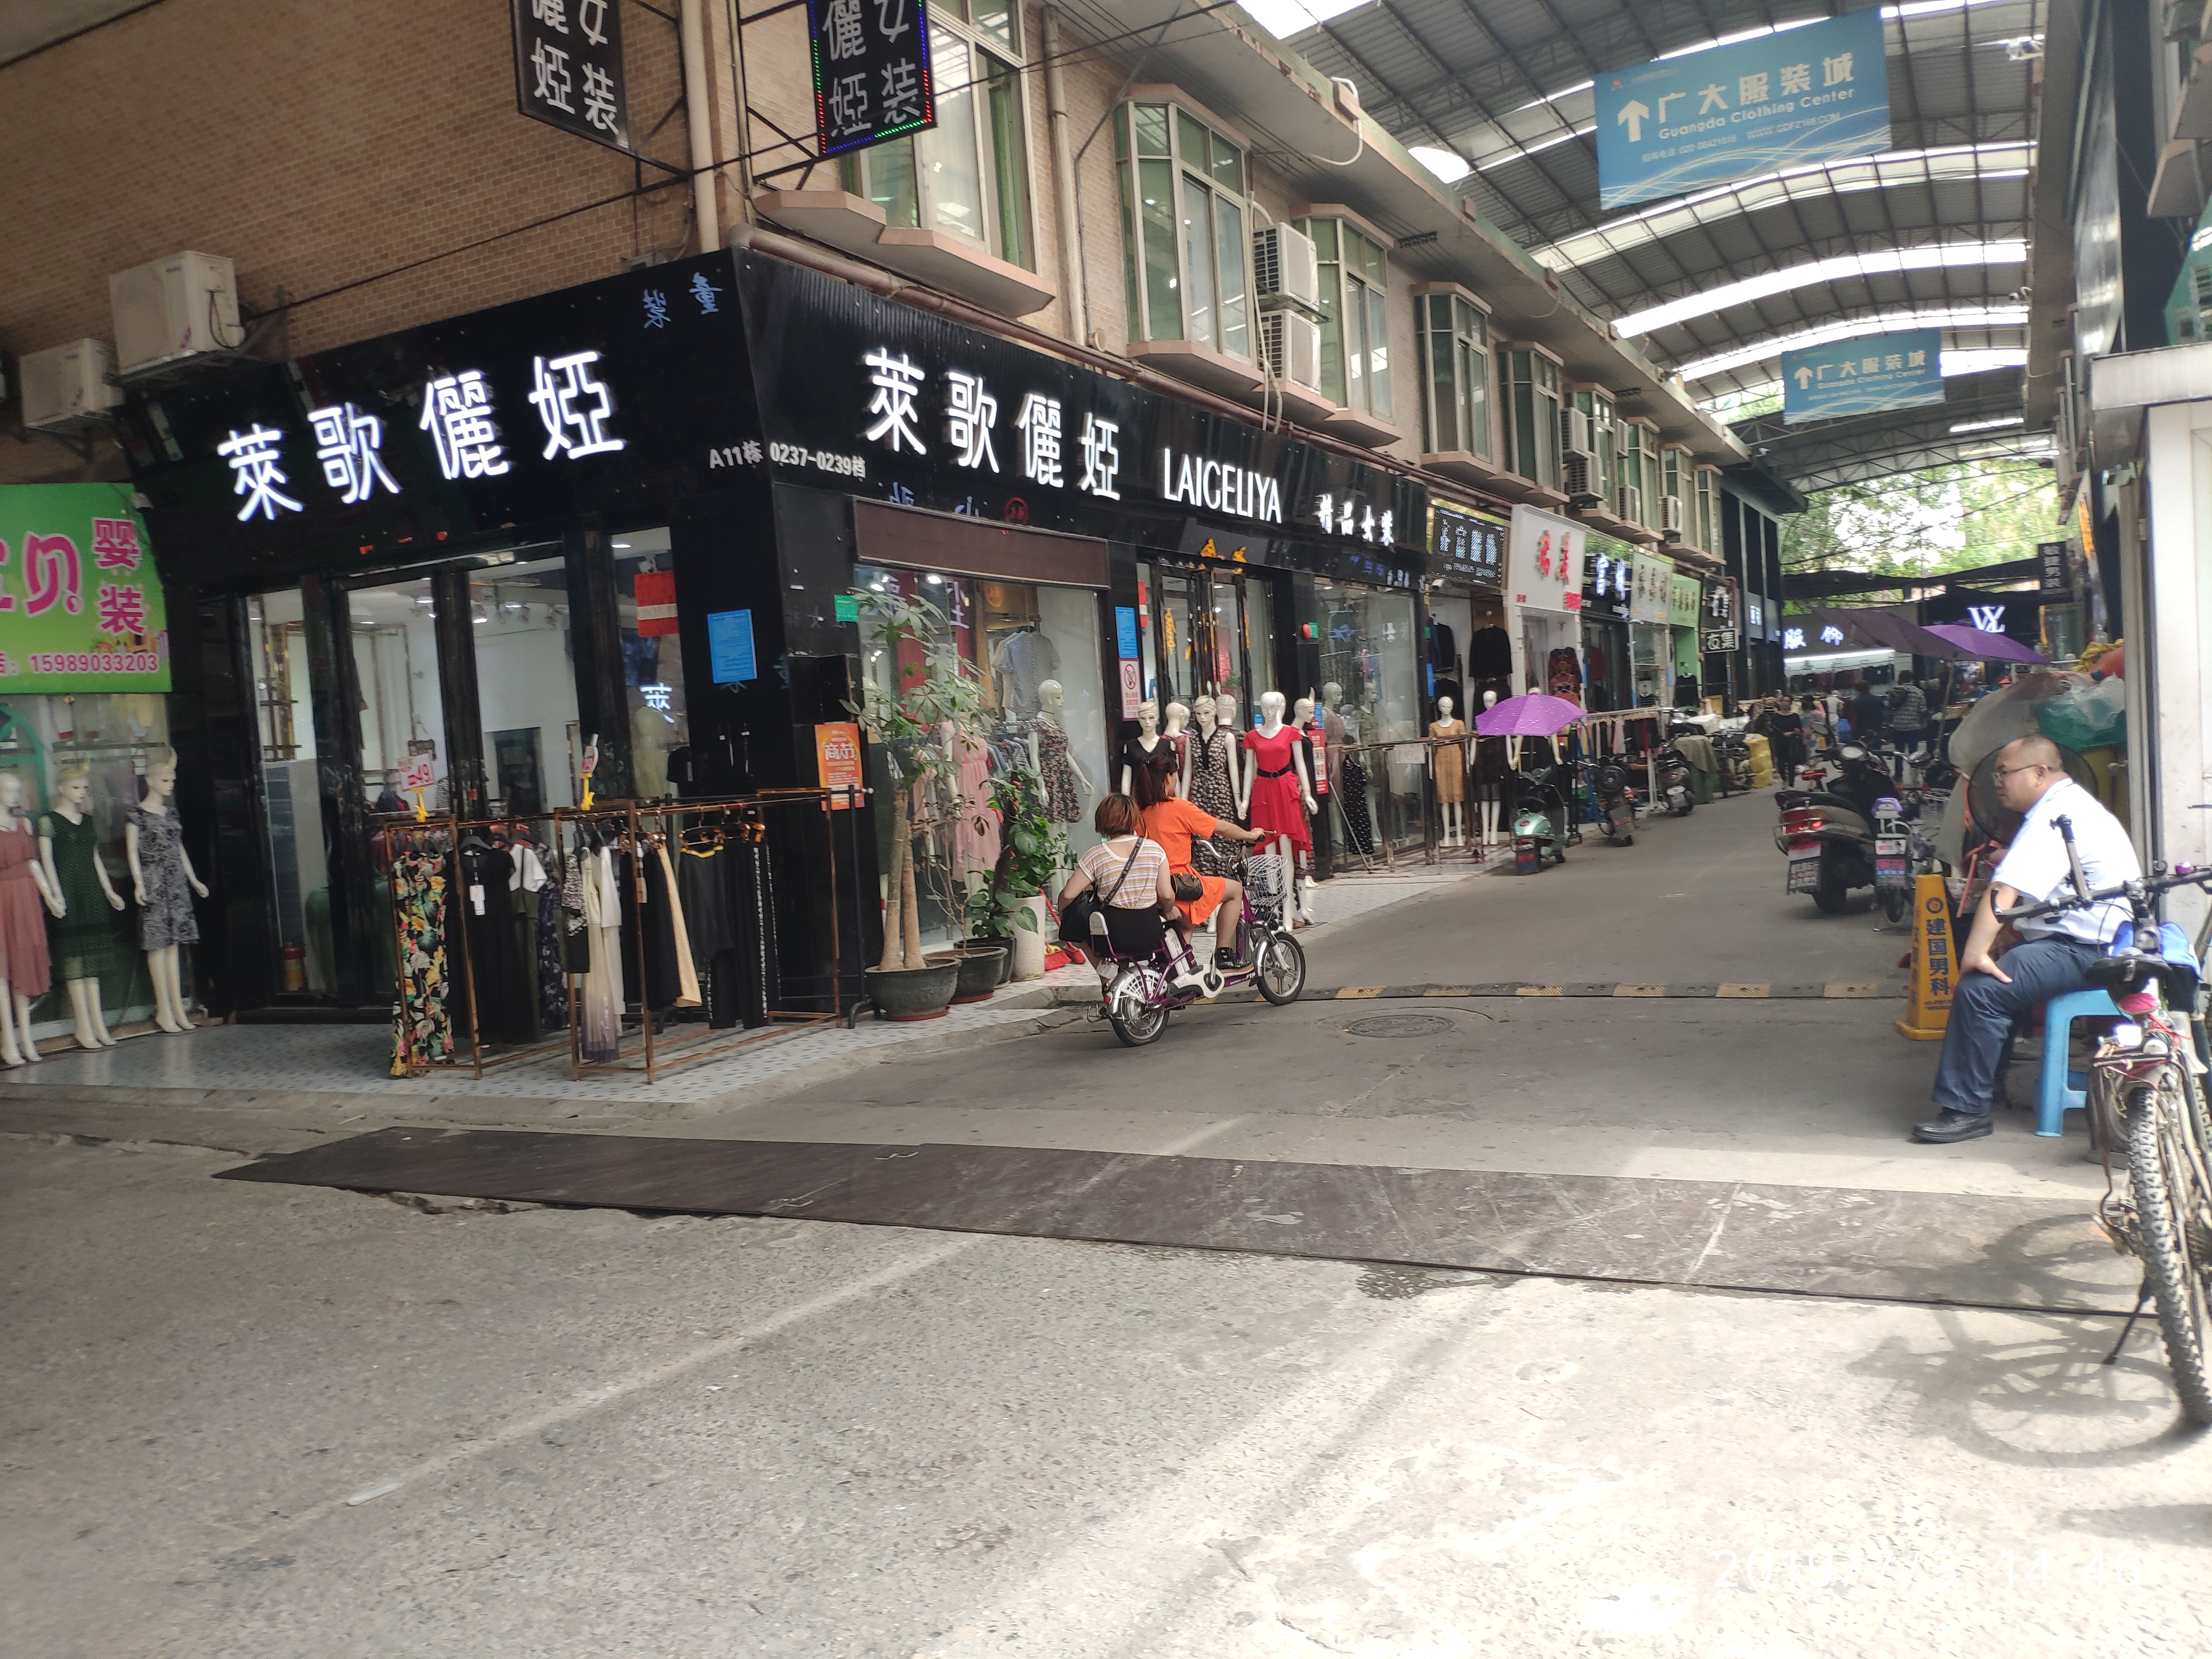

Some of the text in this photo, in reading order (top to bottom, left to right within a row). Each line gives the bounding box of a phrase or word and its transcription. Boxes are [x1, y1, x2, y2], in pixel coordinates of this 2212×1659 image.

[1657, 52, 1854, 124] 广大服装城
[1658, 88, 1855, 139] Guangda Clothing Center
[93, 518, 145, 635] 婴装
[30, 652, 159, 673] 15989033203
